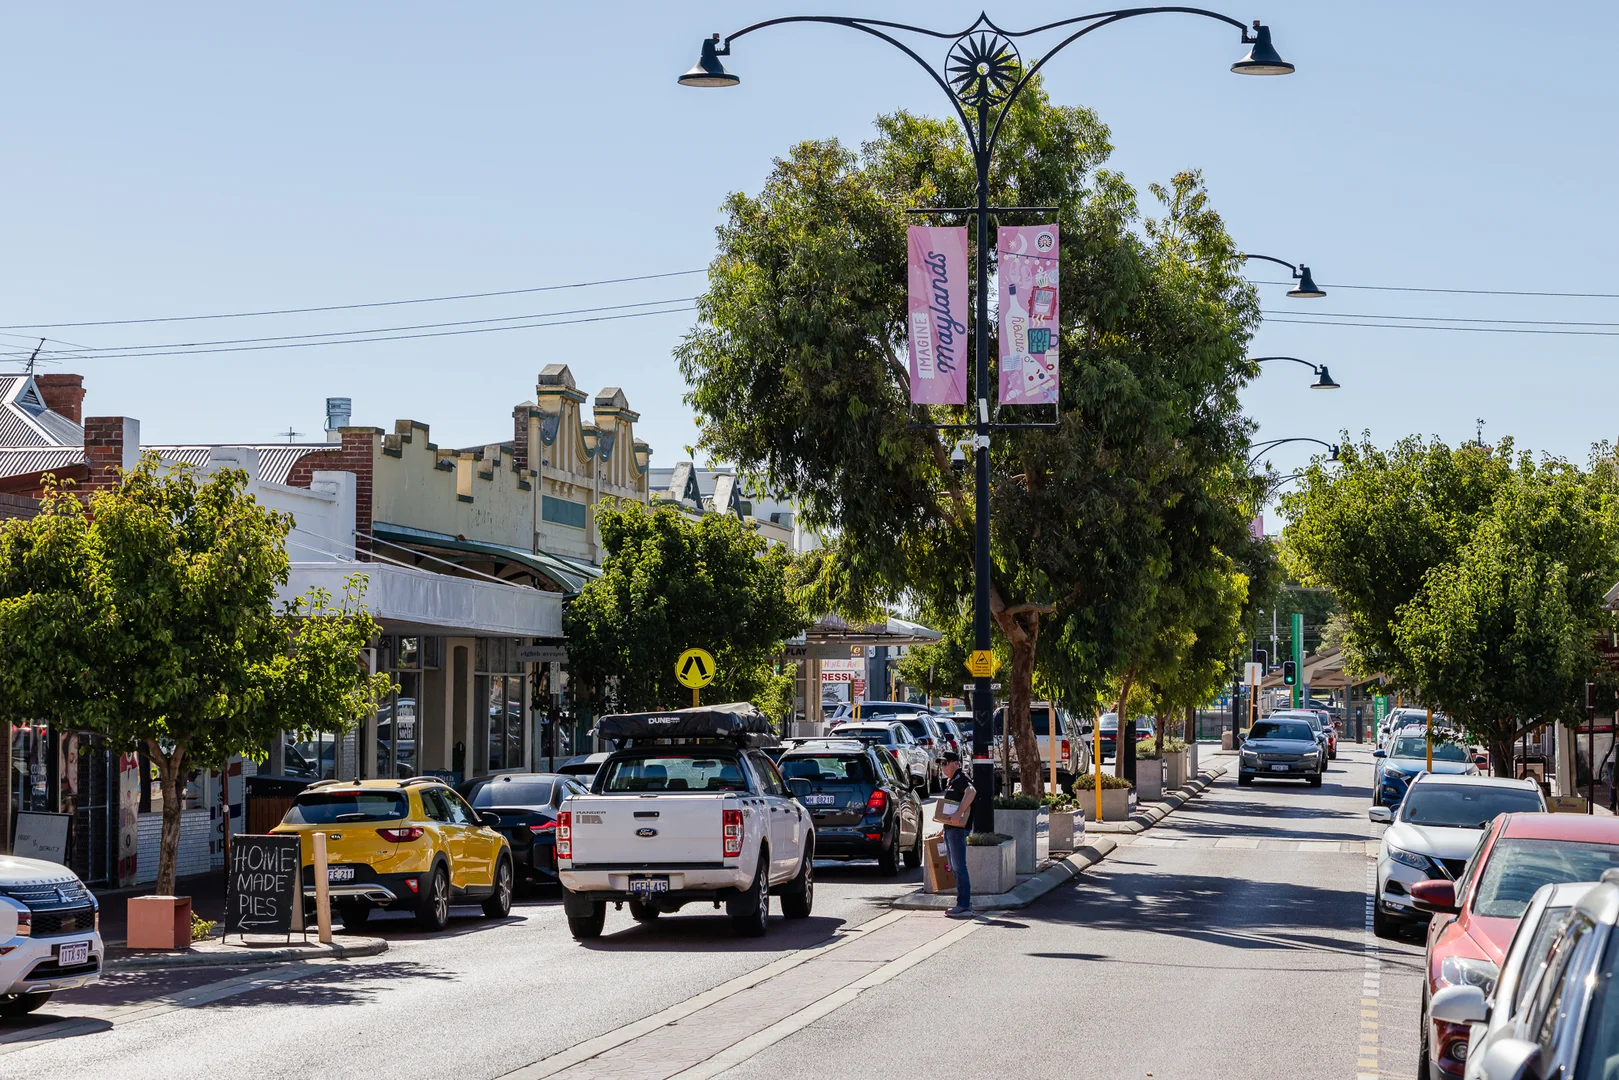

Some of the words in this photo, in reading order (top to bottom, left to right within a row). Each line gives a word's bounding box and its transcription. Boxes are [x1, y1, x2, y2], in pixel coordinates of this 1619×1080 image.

[925, 251, 966, 374] maylands
[915, 317, 932, 372] IMAGINE
[785, 648, 807, 656] PLAY
[234, 845, 294, 872] HOME
[237, 873, 288, 892] MADE
[239, 894, 277, 917] PIES
